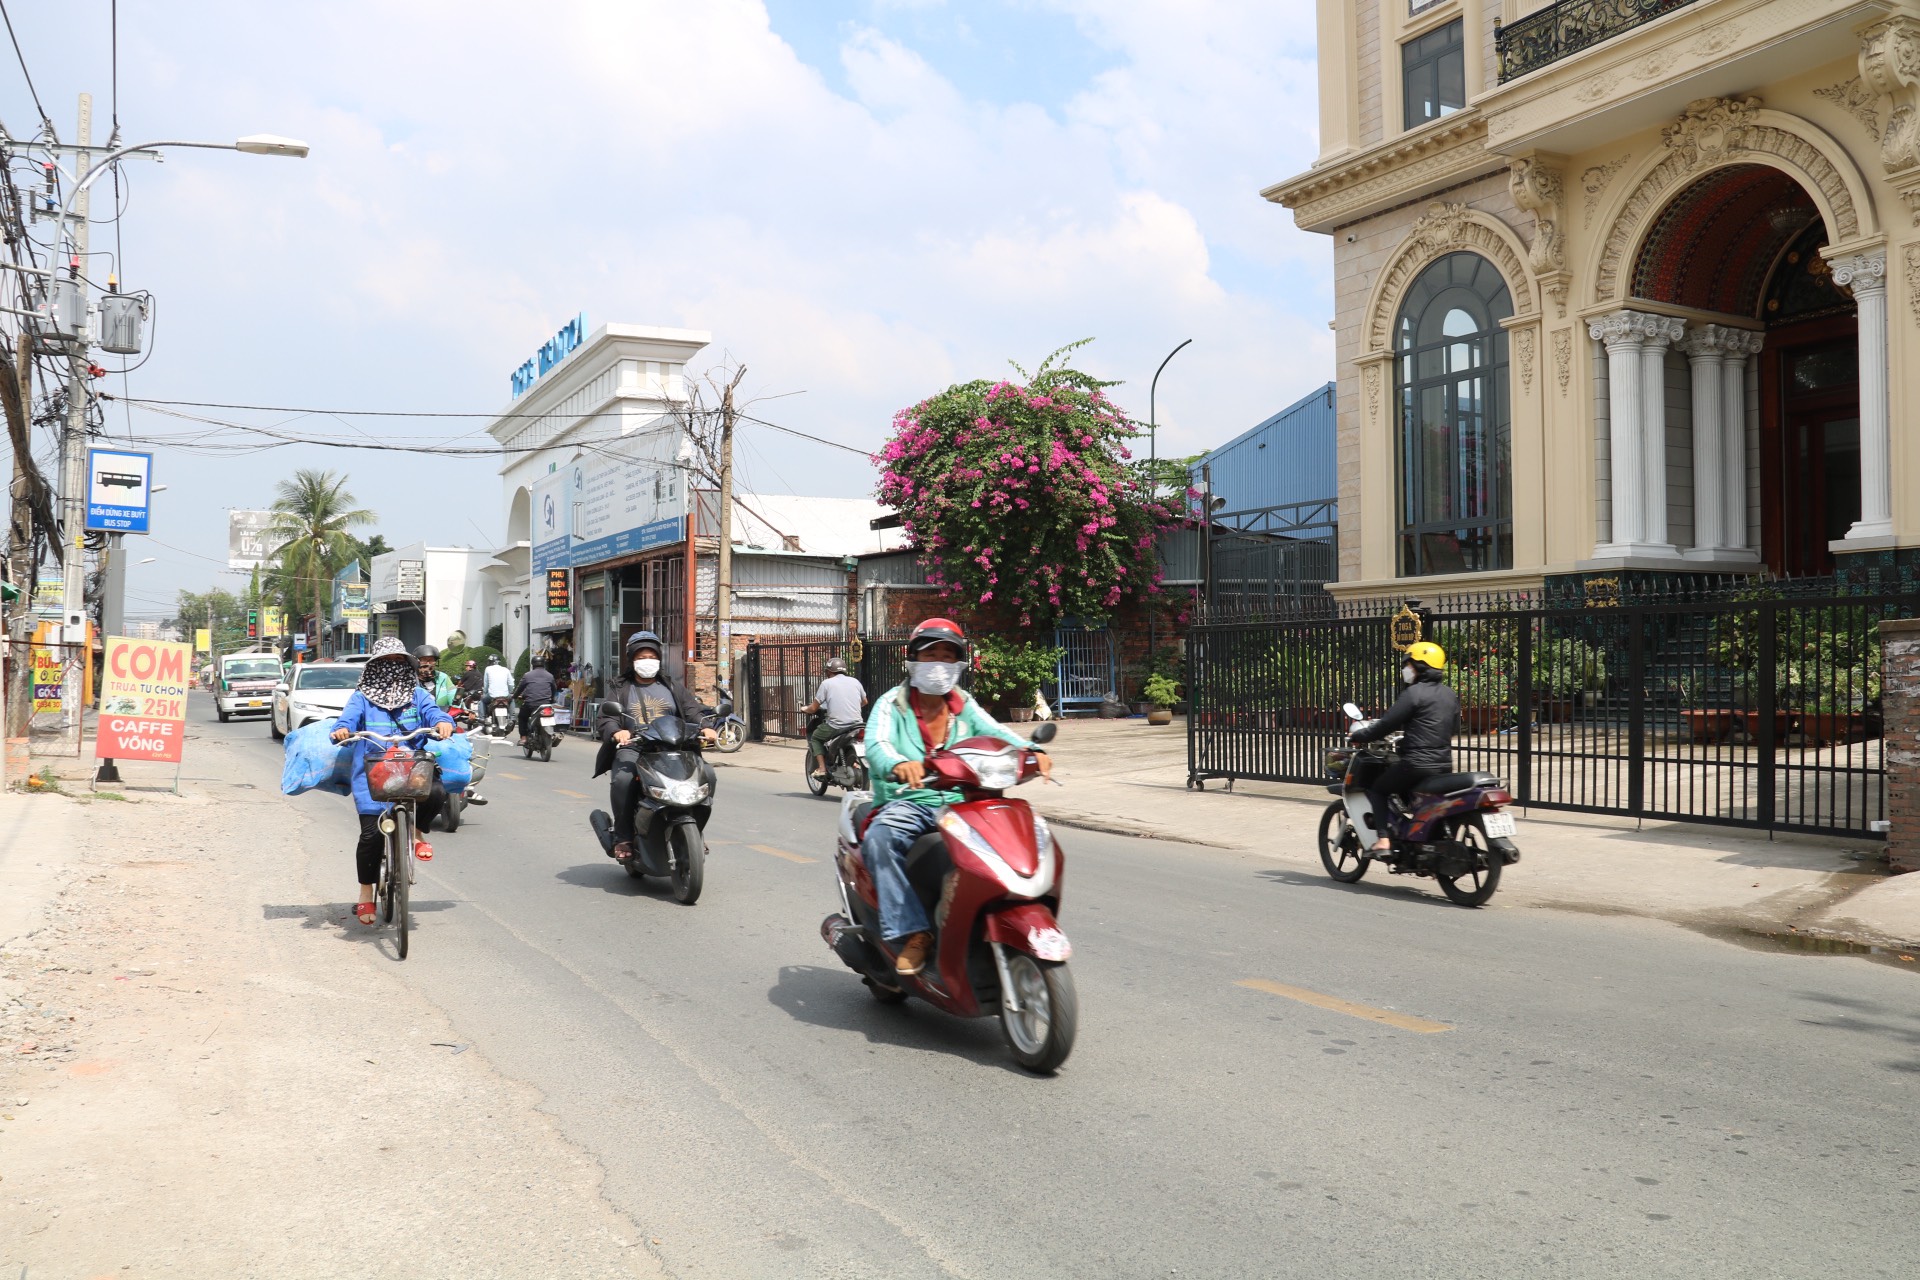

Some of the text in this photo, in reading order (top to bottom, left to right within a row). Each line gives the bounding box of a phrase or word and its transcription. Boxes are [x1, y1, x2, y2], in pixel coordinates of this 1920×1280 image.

[123, 510, 131, 518] XE
[104, 519, 131, 528] BUS STOP
[111, 643, 183, 682] CƠM
[144, 698, 180, 717] 25K
[110, 719, 173, 736] CAFFE
[118, 735, 165, 752] VÕNG
